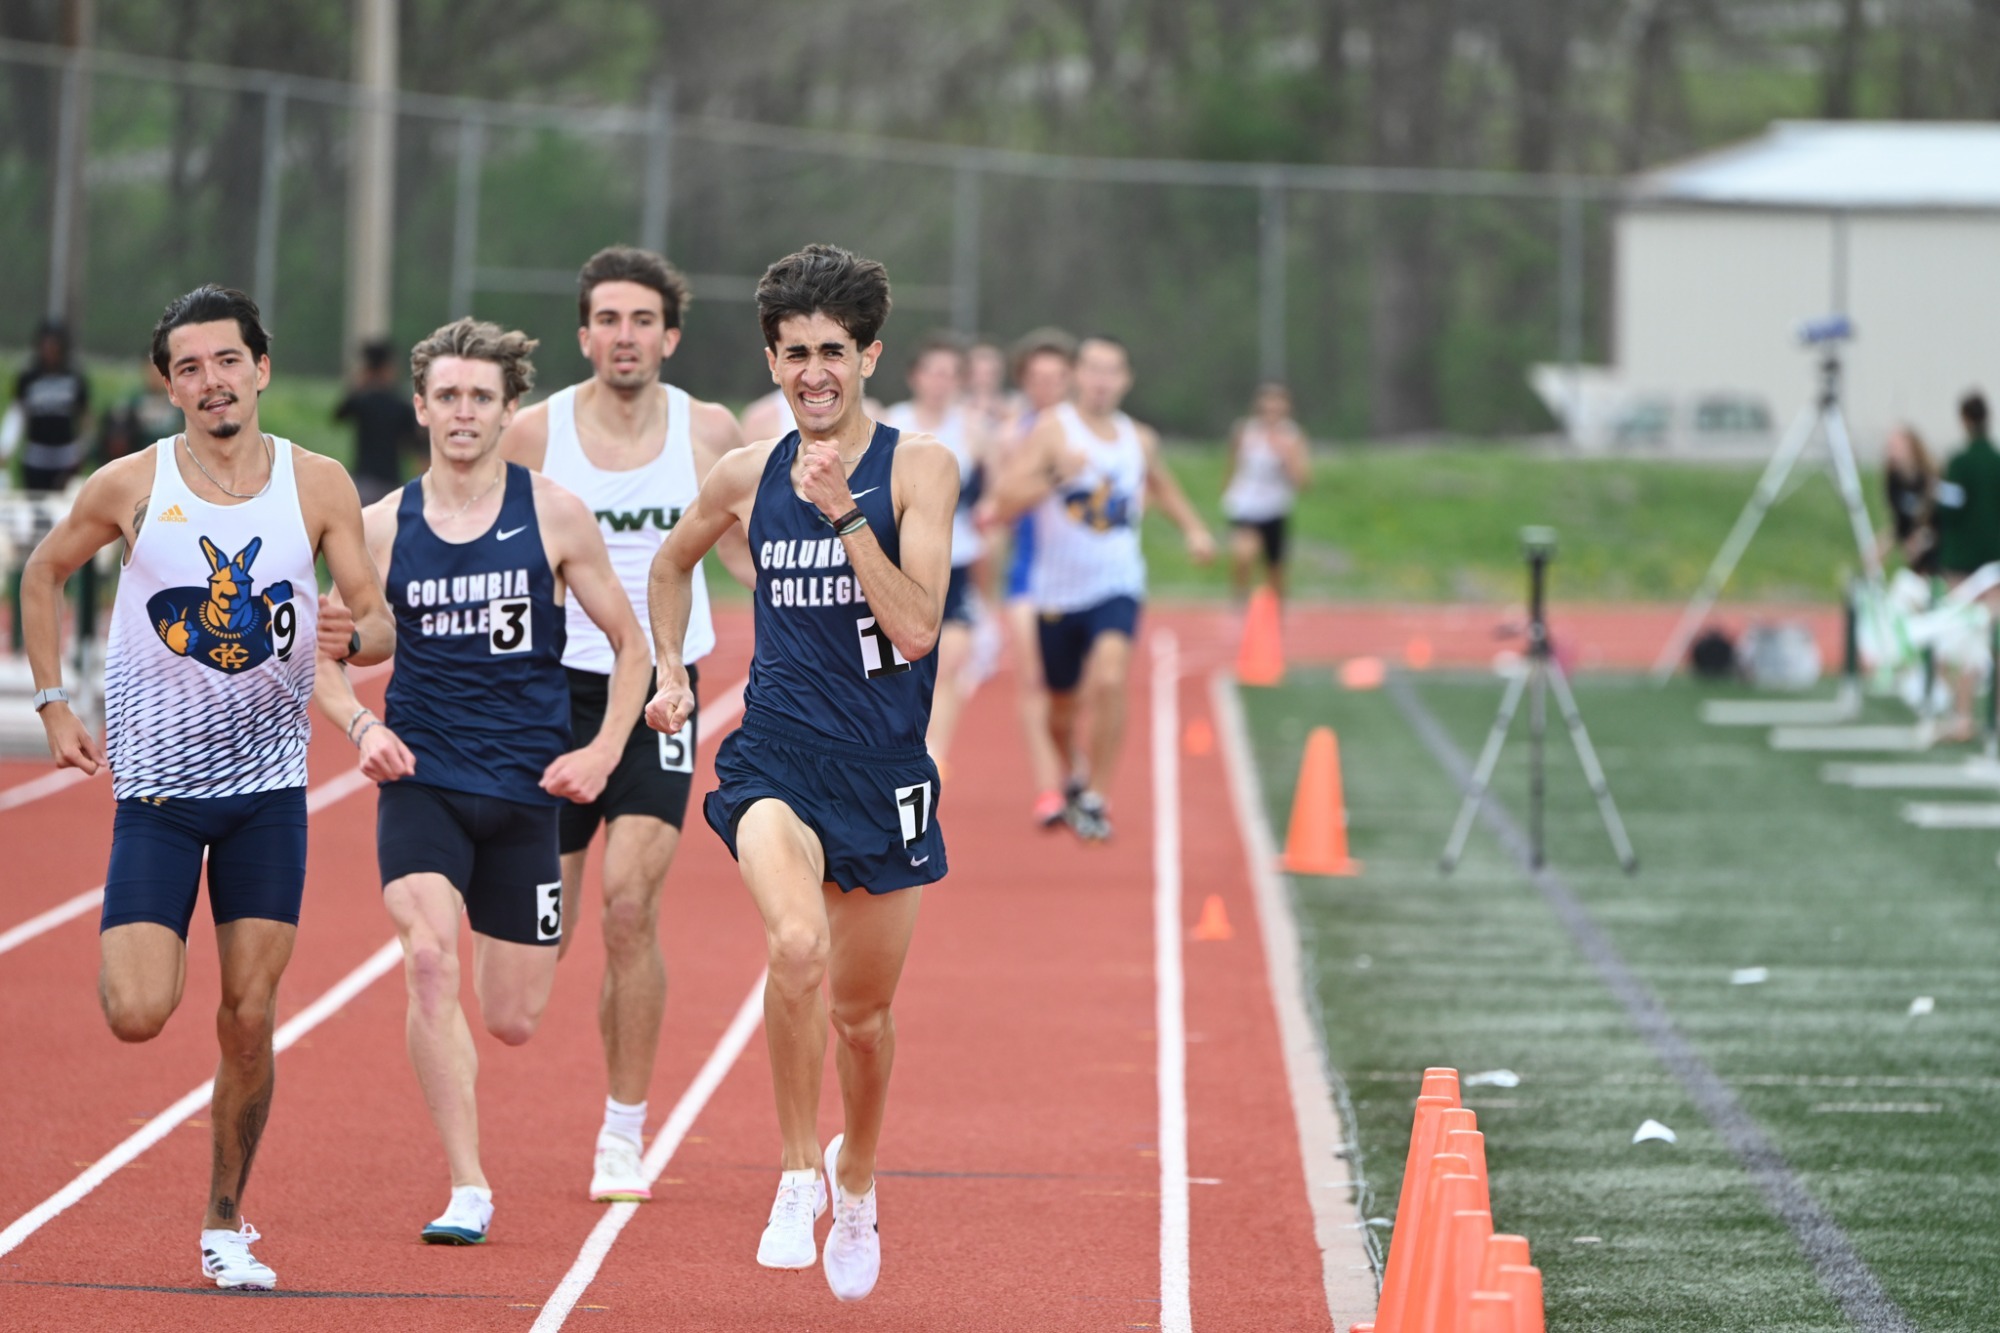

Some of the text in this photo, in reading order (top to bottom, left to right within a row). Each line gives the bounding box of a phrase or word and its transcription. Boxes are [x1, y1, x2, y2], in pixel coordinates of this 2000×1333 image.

[158, 514, 187, 522] adidas
[594, 506, 681, 532] WU
[760, 538, 853, 569] COLUMB
[407, 569, 529, 608] COLUMBIA
[273, 602, 296, 657] 9
[421, 608, 490, 636] COLLE
[492, 603, 528, 651] 3
[860, 616, 910, 679] 1
[665, 730, 684, 767] 5
[899, 786, 926, 848] 1
[541, 886, 562, 936] 3
